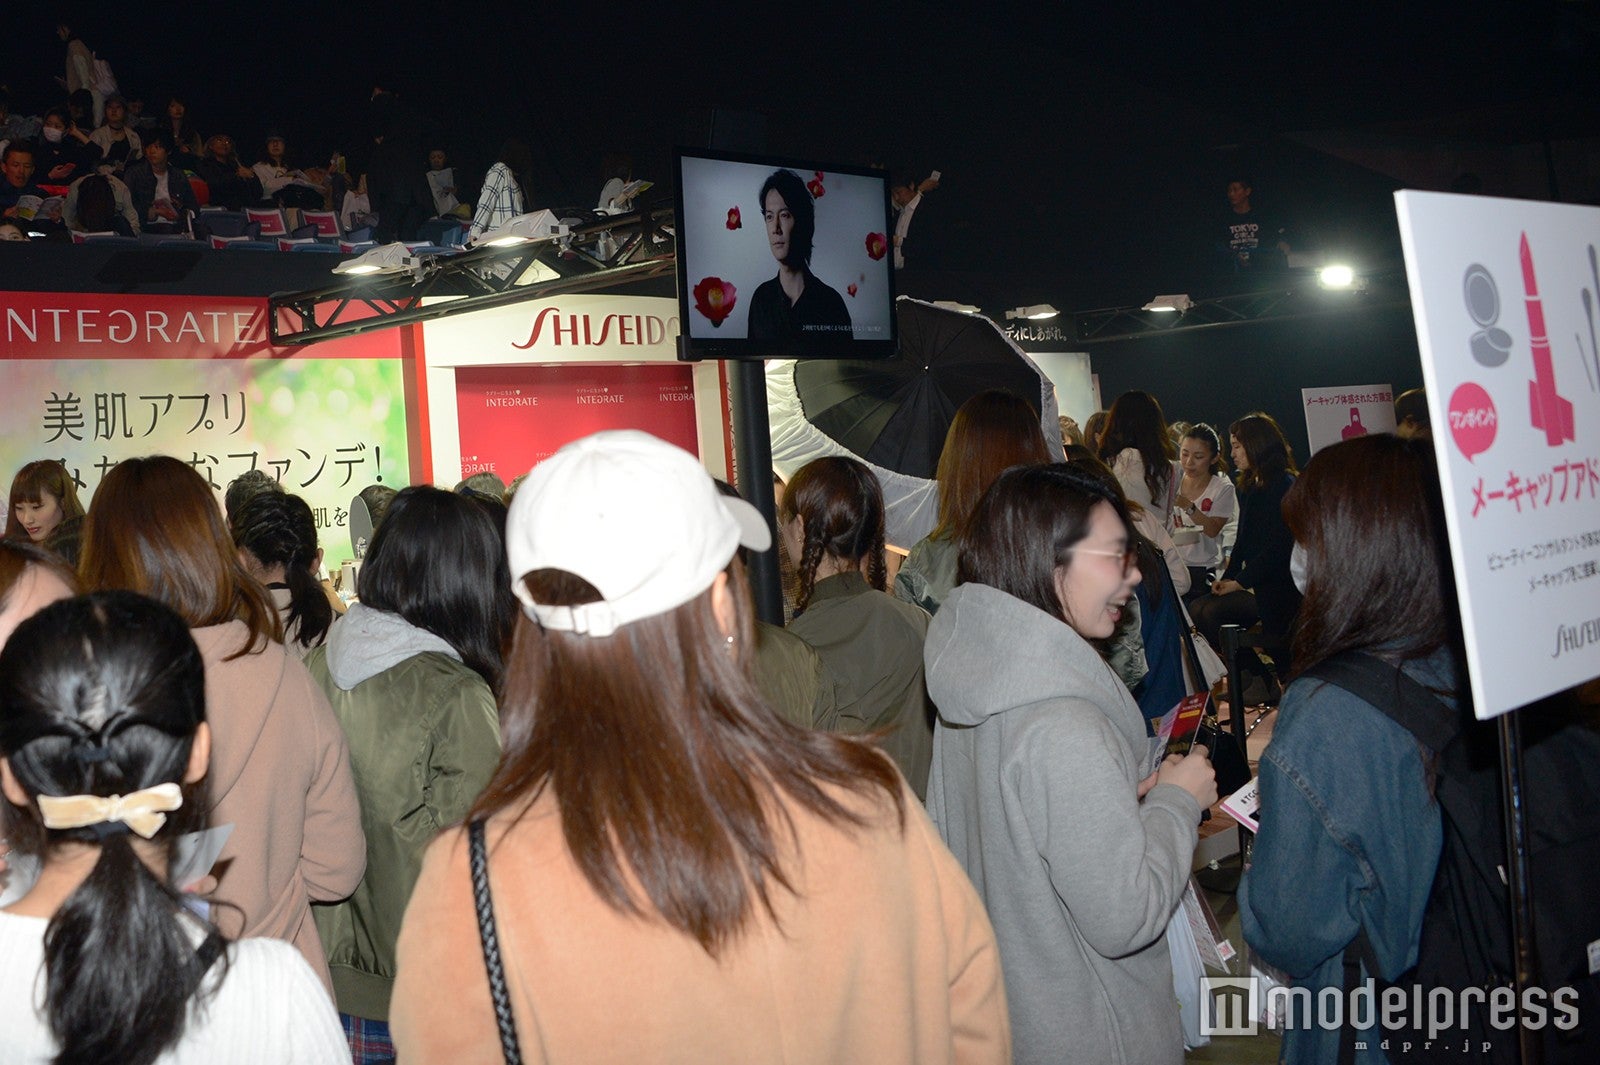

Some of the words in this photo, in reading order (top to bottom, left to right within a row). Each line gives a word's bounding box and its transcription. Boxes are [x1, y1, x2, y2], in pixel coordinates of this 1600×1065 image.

[1229, 224, 1259, 233] TOKYO
[486, 397, 538, 407] INTEGRATE
[576, 394, 625, 404] INTEGRATE
[43, 391, 247, 444] 美肌アプリ
